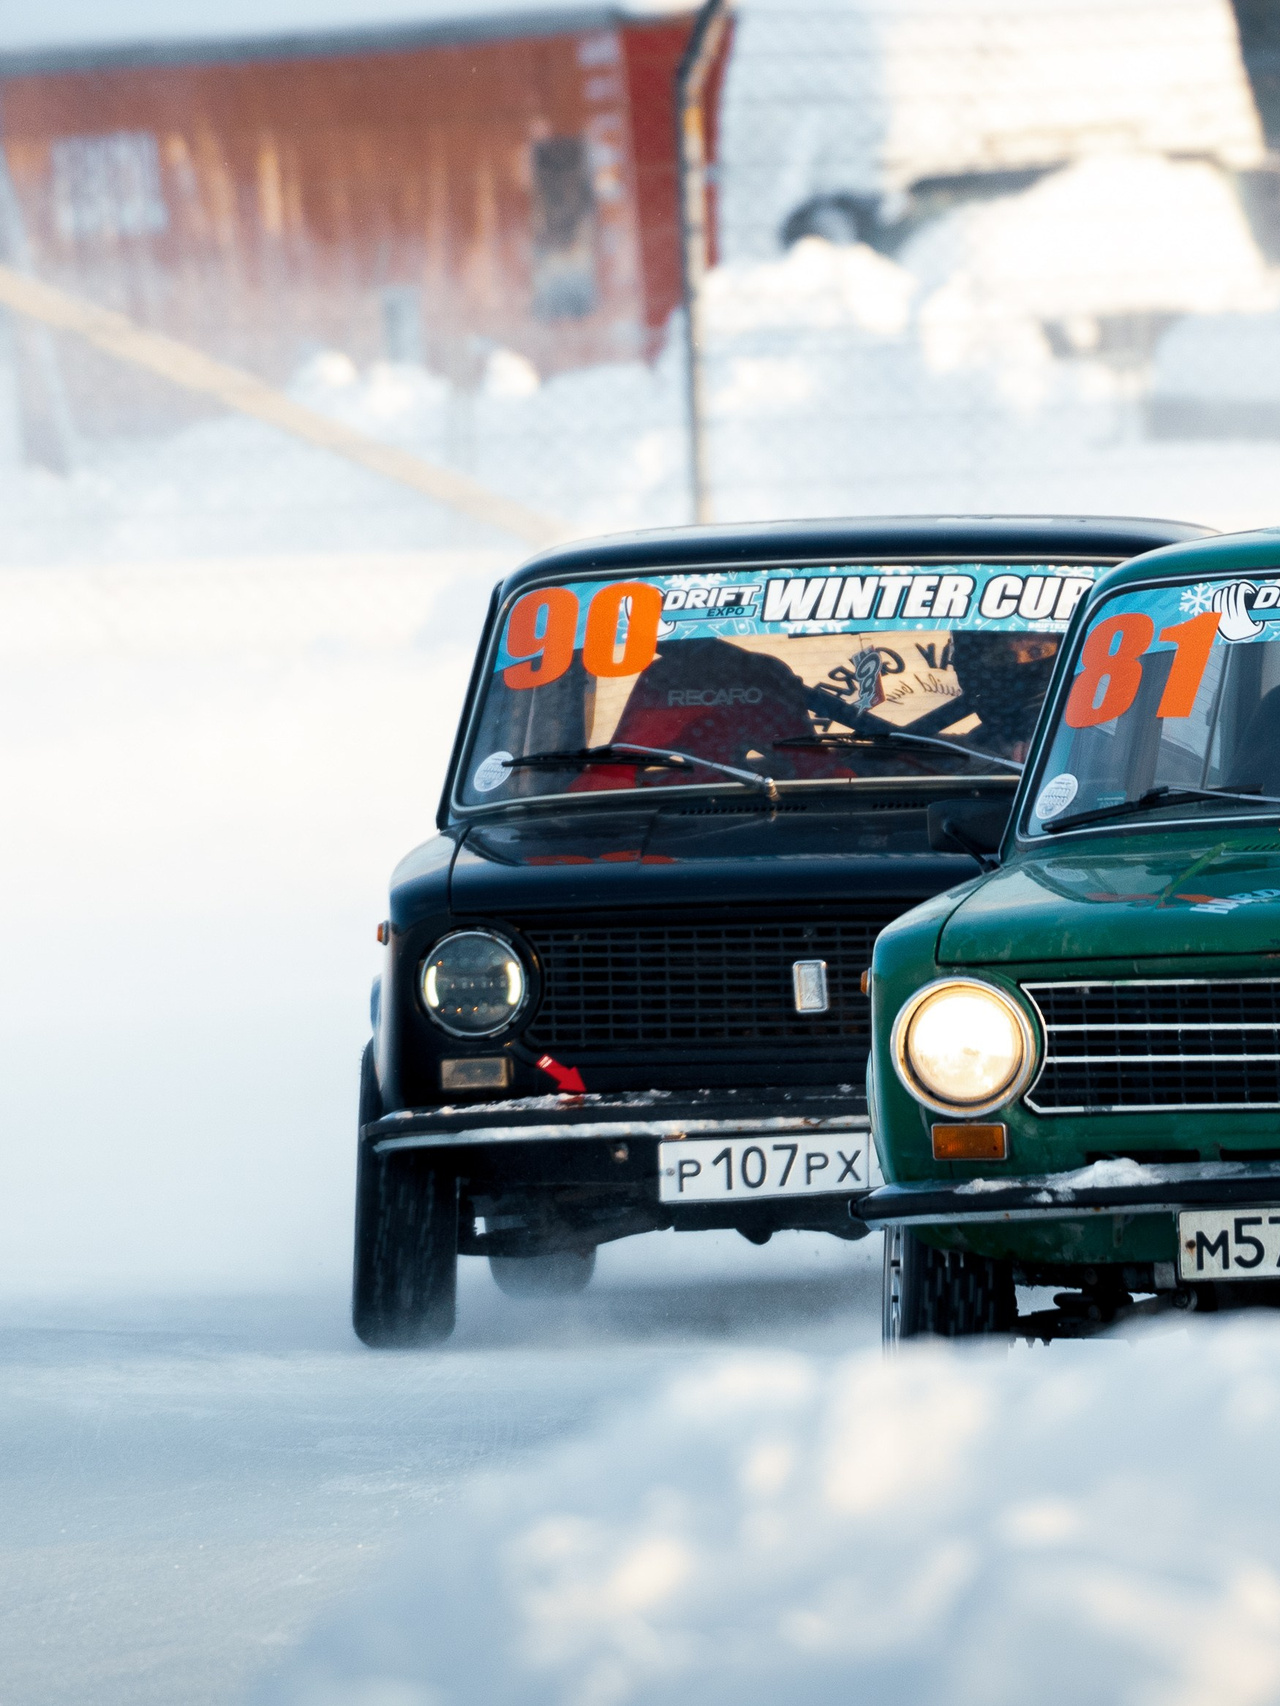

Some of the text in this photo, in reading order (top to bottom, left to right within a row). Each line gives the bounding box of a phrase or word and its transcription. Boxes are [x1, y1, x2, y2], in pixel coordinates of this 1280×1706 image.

[663, 585, 761, 611] DRIFT
[706, 606, 746, 617] EXPO
[763, 576, 975, 621] WINTER
[504, 581, 663, 689] 90
[1064, 612, 1223, 729] 81
[667, 686, 762, 707] RECARO
